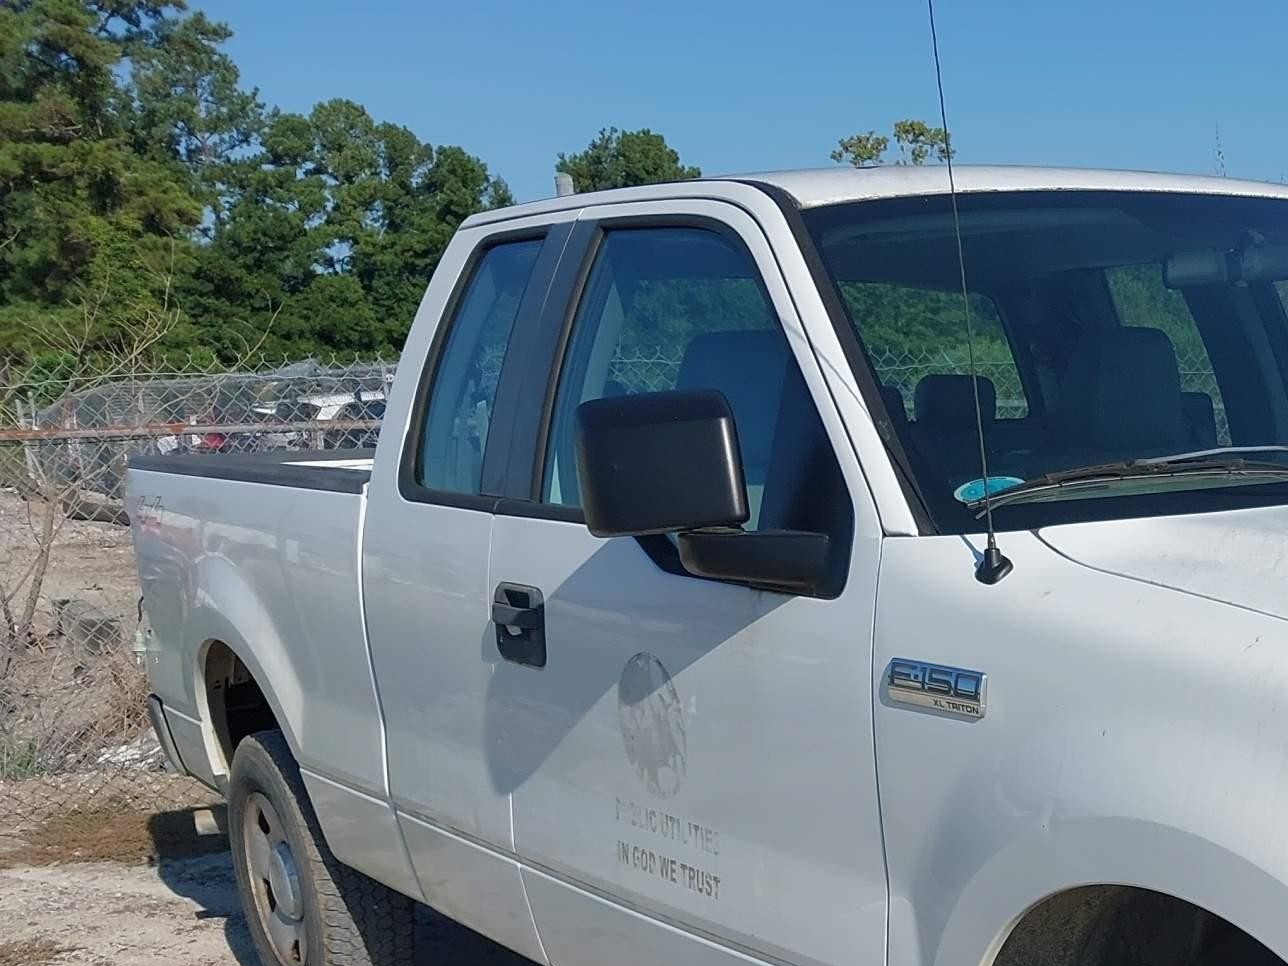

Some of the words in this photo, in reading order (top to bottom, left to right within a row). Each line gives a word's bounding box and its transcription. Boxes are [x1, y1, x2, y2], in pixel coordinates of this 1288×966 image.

[889, 661, 982, 701] F-150
[933, 698, 945, 708] XL
[946, 701, 980, 715] TRITON
[615, 796, 657, 833] PBLIC
[617, 840, 630, 864] IN
[633, 846, 656, 874] GOD
[659, 855, 677, 884] WE
[680, 863, 721, 900] TRUST
